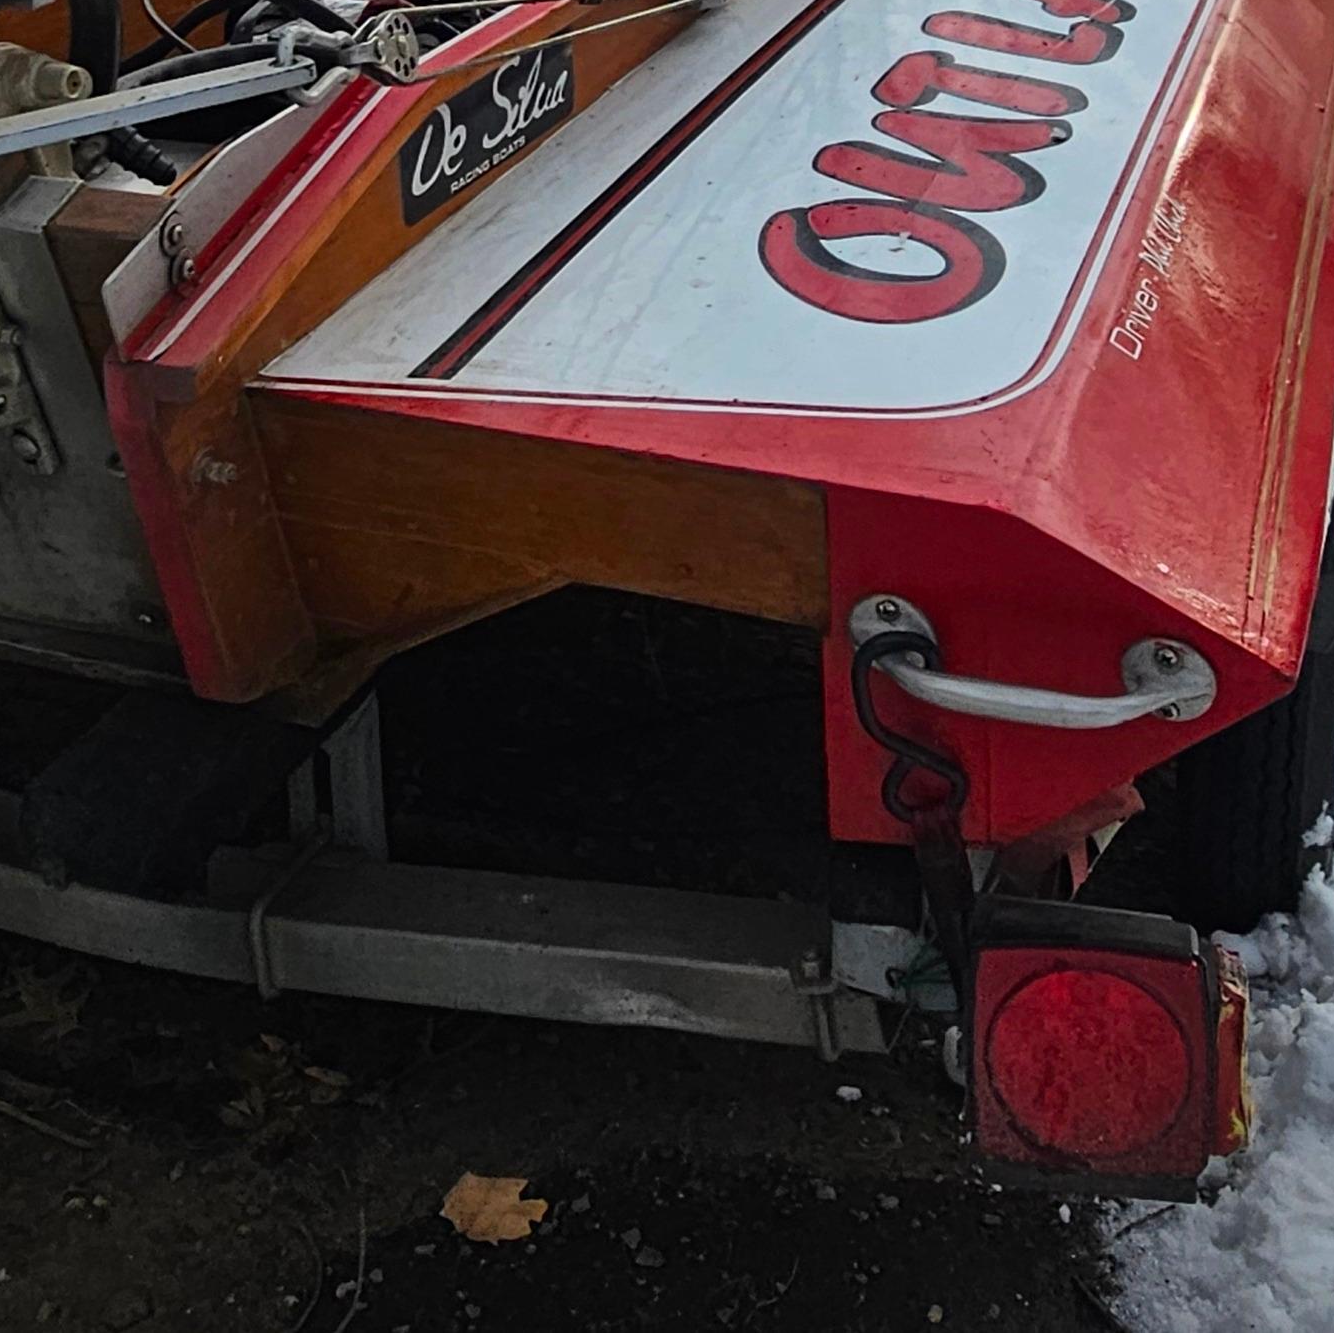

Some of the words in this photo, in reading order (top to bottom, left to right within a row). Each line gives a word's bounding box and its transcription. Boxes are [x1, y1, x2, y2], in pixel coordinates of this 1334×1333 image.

[411, 102, 467, 197] De
[481, 50, 569, 149] Silva
[450, 158, 491, 194] RACING
[491, 135, 527, 167] BOATS
